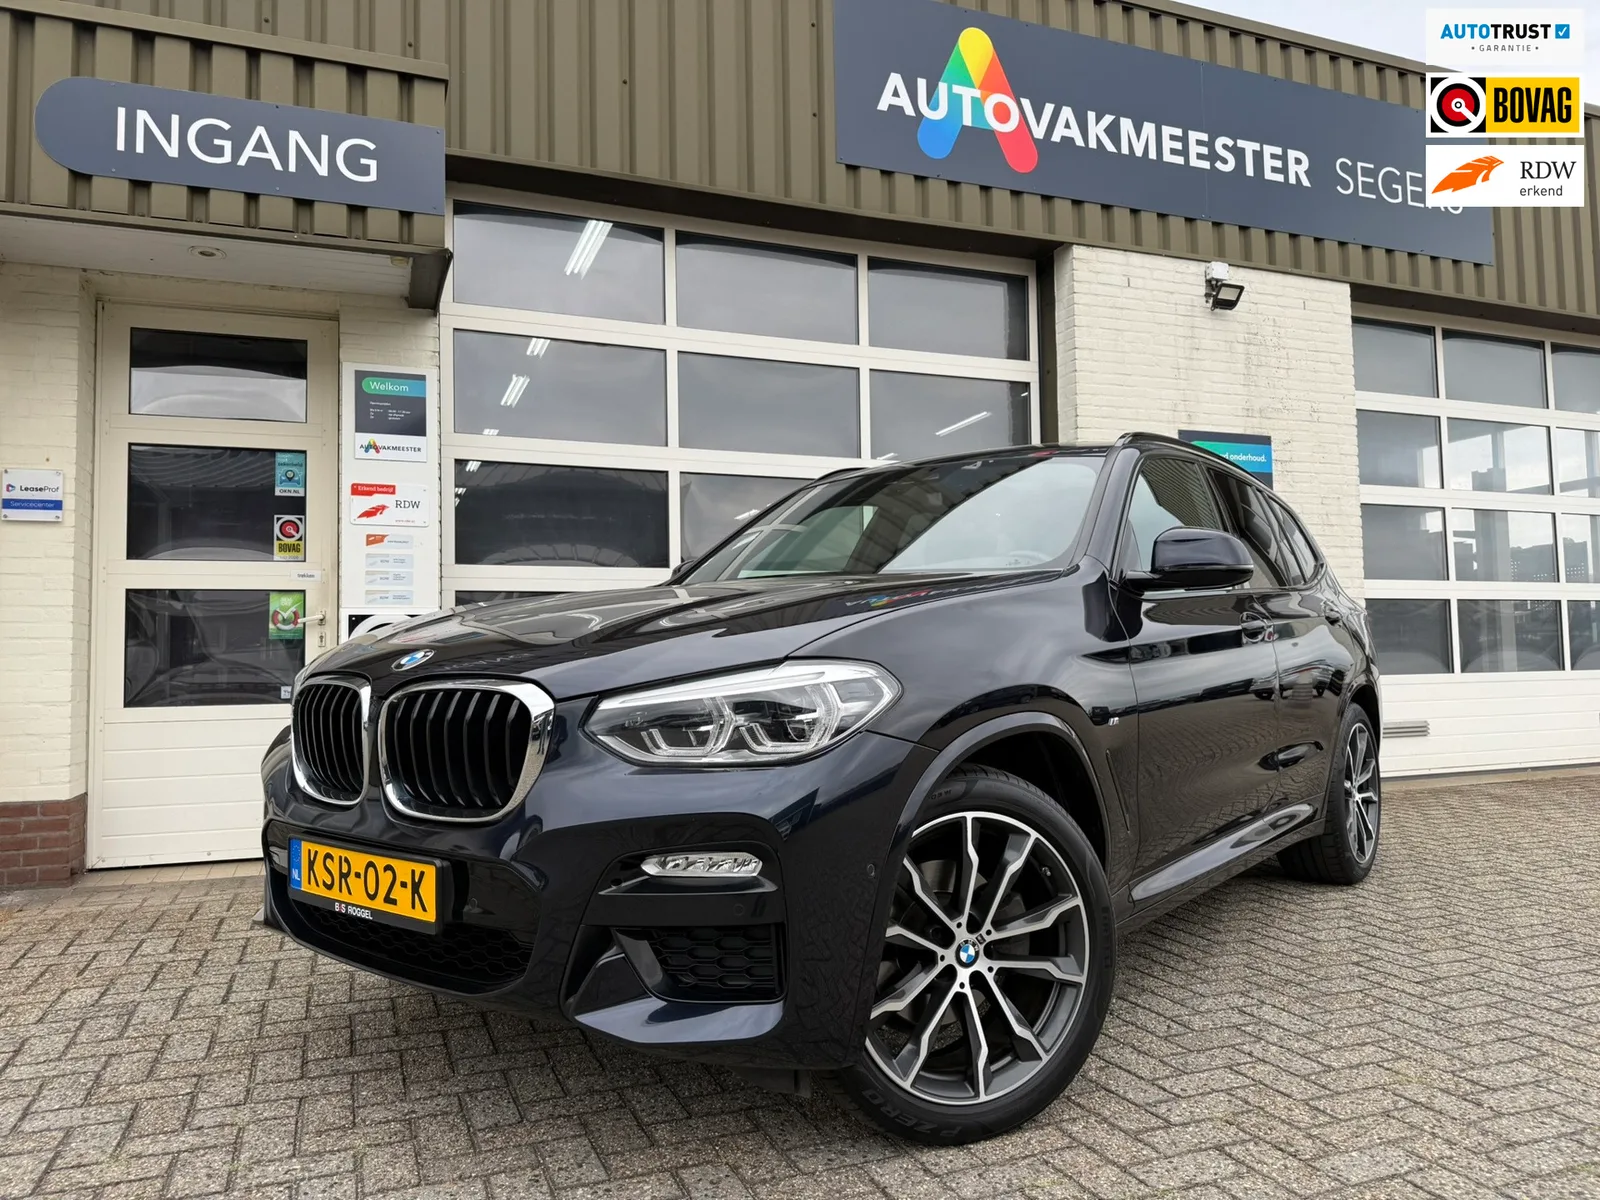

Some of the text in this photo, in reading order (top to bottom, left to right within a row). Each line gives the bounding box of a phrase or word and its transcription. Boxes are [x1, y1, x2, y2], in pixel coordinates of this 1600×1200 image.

[115, 106, 378, 183] INGANG
[877, 72, 1464, 215] AUTOVAKMEESTER SEGE
[369, 381, 409, 392] Welkom
[359, 443, 422, 453] AUTOVAKMEESTER
[1229, 453, 1267, 462] onderhoud.
[19, 485, 60, 493] LeaseProf
[10, 500, 55, 508] Servicecenter
[395, 500, 421, 509] RDW
[278, 542, 301, 553] BOVAG
[292, 868, 300, 881] NL
[307, 848, 428, 913] KSR-02-K
[347, 905, 374, 920] ROGGEL
